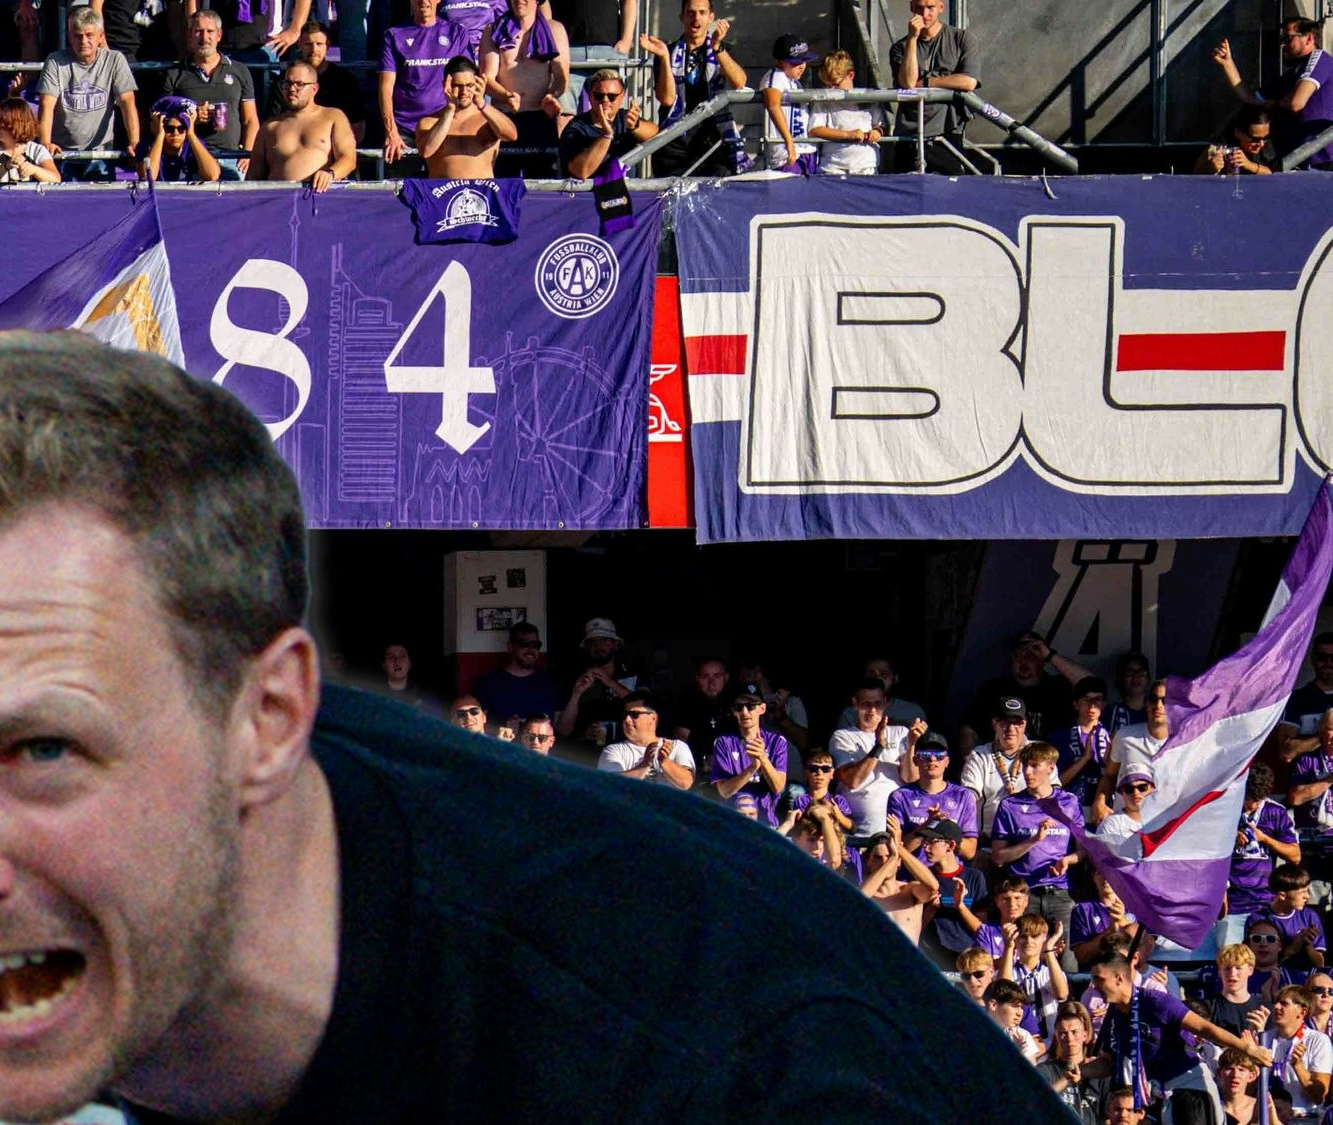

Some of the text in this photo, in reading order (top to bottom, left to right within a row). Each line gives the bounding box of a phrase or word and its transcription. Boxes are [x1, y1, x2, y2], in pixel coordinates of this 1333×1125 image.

[550, 239, 607, 266] FUSSBALLKLUB
[549, 287, 605, 310] AUSTRIA WIEN
